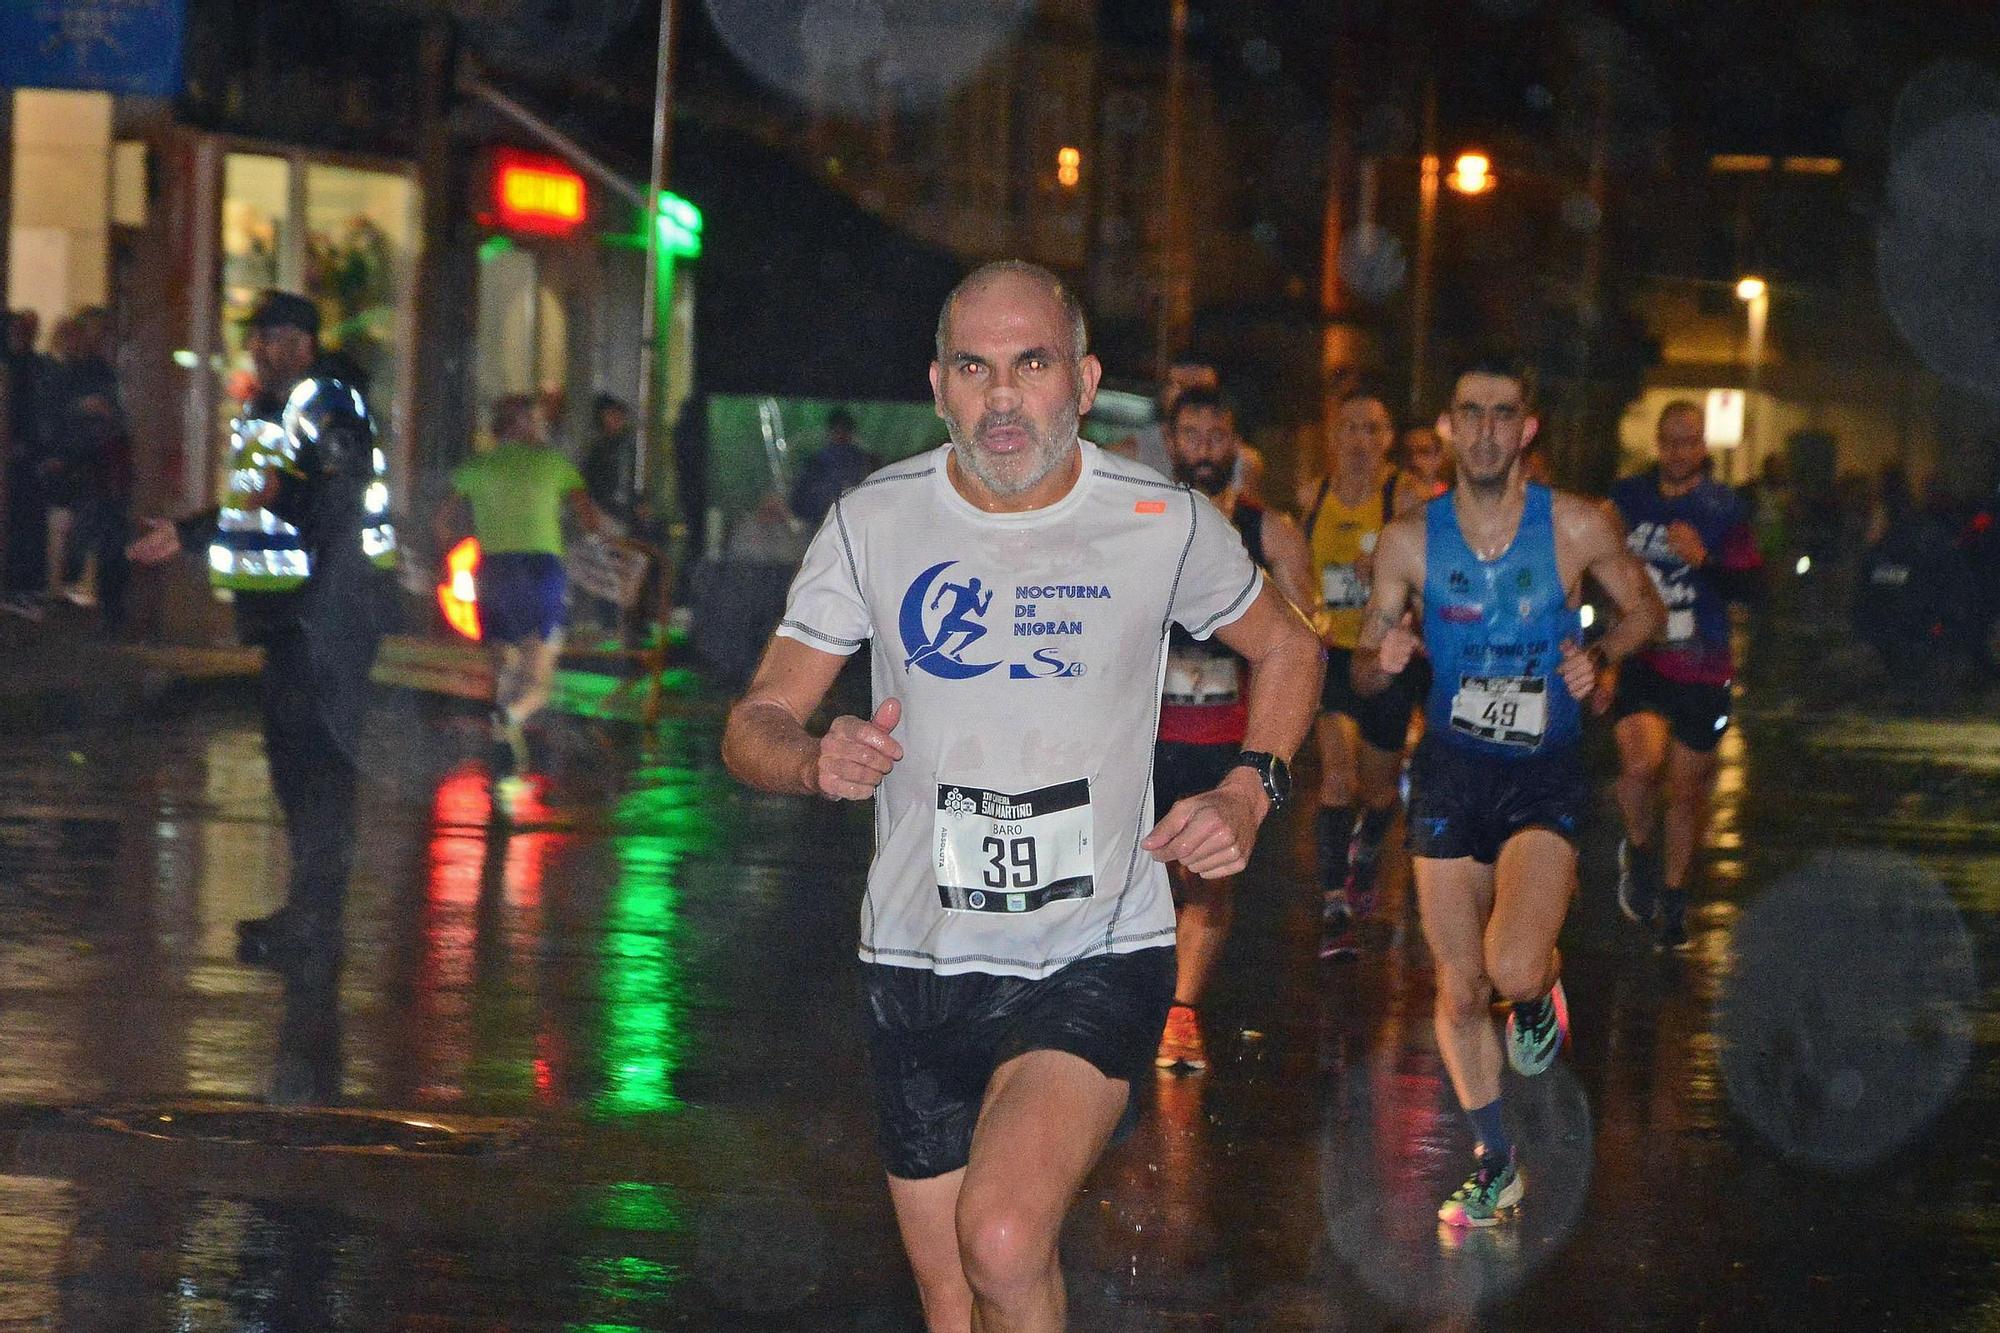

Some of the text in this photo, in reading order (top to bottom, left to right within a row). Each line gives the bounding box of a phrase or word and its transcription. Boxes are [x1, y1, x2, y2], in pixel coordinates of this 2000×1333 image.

[1015, 585, 1111, 599] NOCTURNA
[1015, 604, 1036, 617] DE
[1013, 621, 1082, 636] NIGRAN
[1481, 701, 1518, 727] 49
[993, 824, 1022, 835] BARO
[939, 827, 948, 868] ABSOLUTA
[982, 836, 1039, 888] 39
